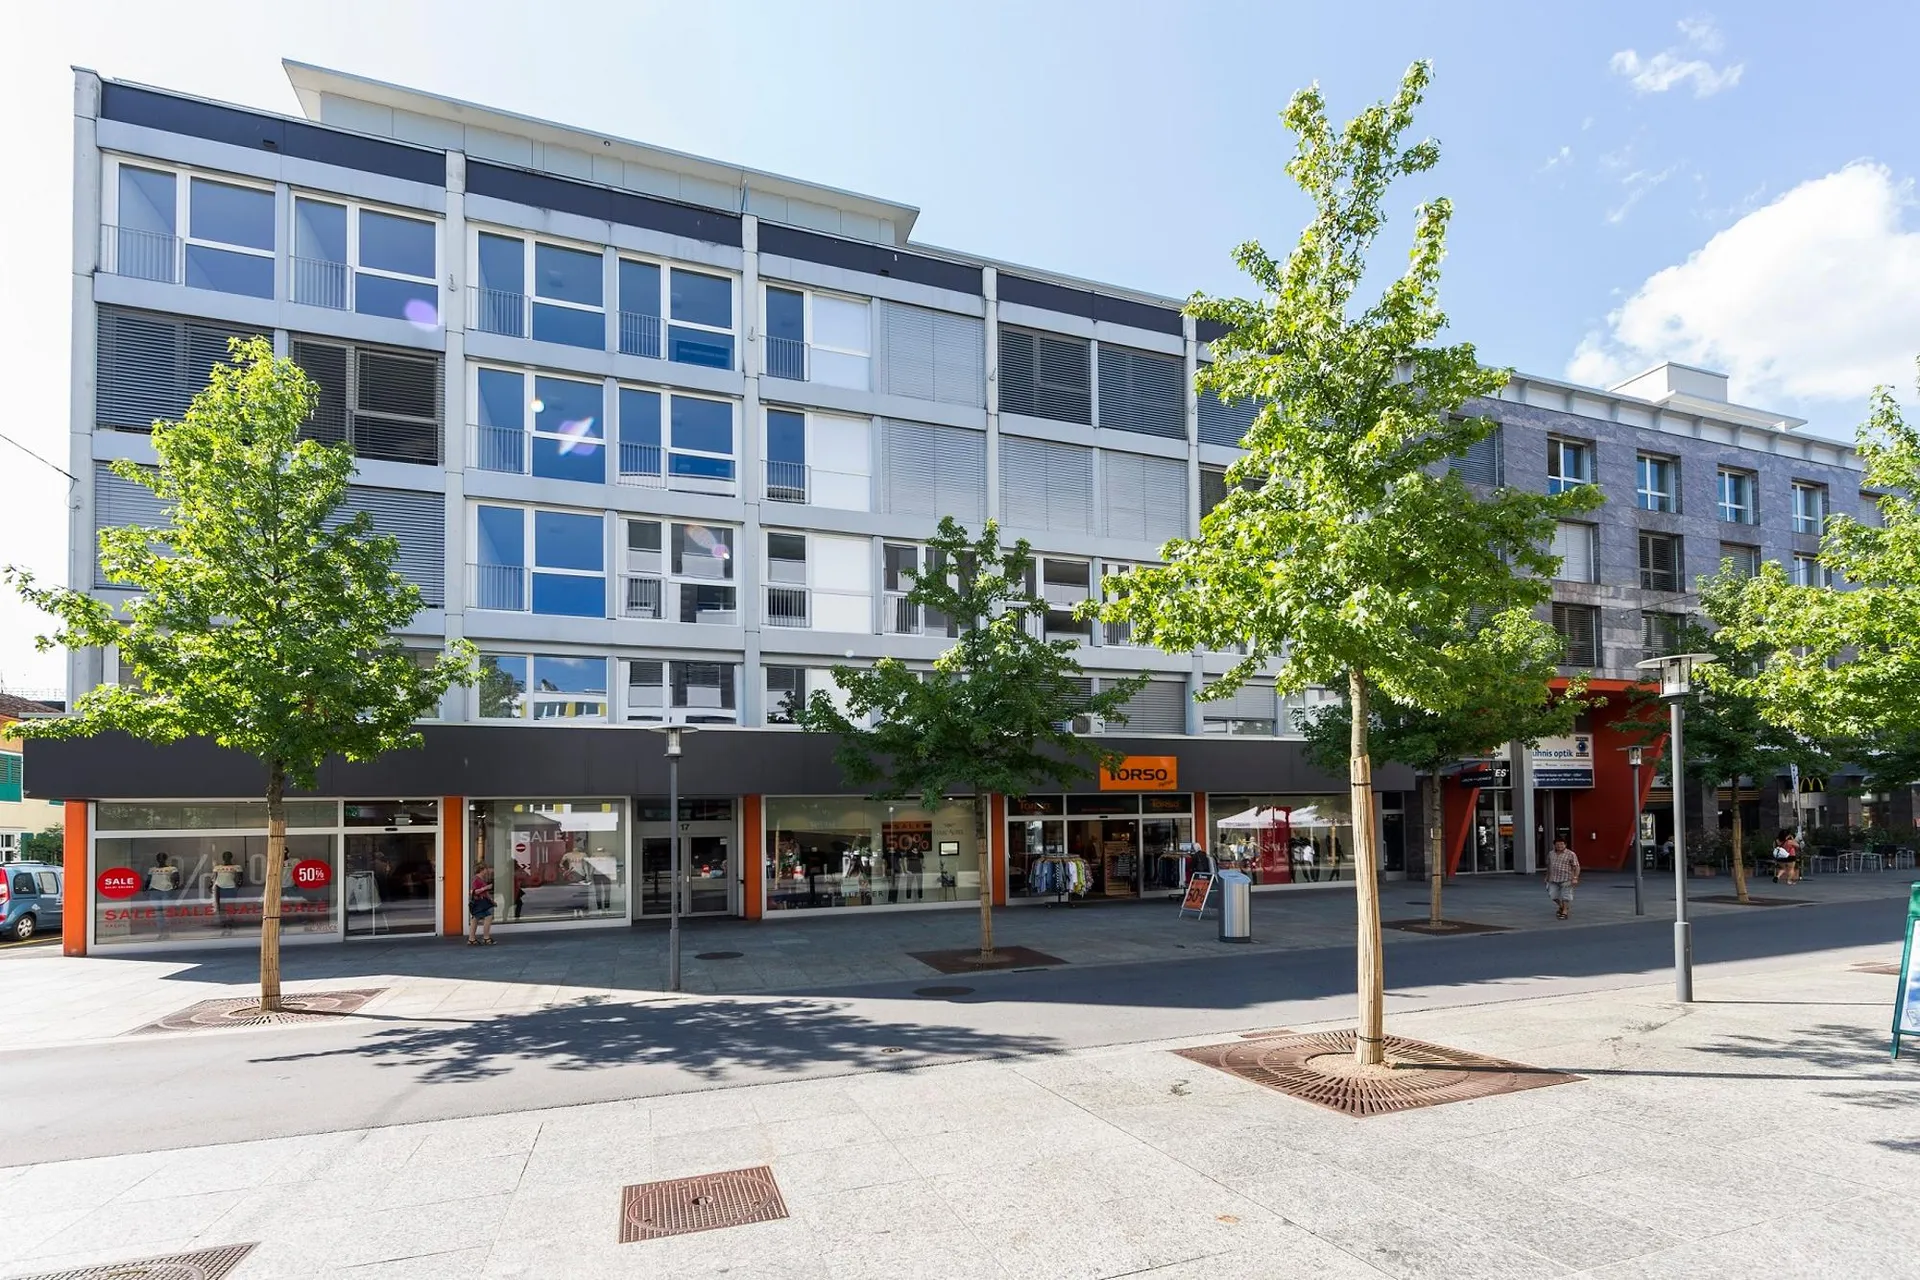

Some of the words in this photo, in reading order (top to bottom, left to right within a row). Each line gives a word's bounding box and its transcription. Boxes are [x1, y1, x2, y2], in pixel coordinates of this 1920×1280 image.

[1553, 749, 1574, 758] optik
[681, 823, 690, 831] 17
[885, 833, 929, 850] 50%
[298, 867, 325, 882] 50%
[104, 877, 134, 886] SALE
[104, 908, 156, 921] SALE
[164, 904, 216, 918] SALE
[224, 902, 263, 915] SAL
[281, 901, 328, 913] SALE
